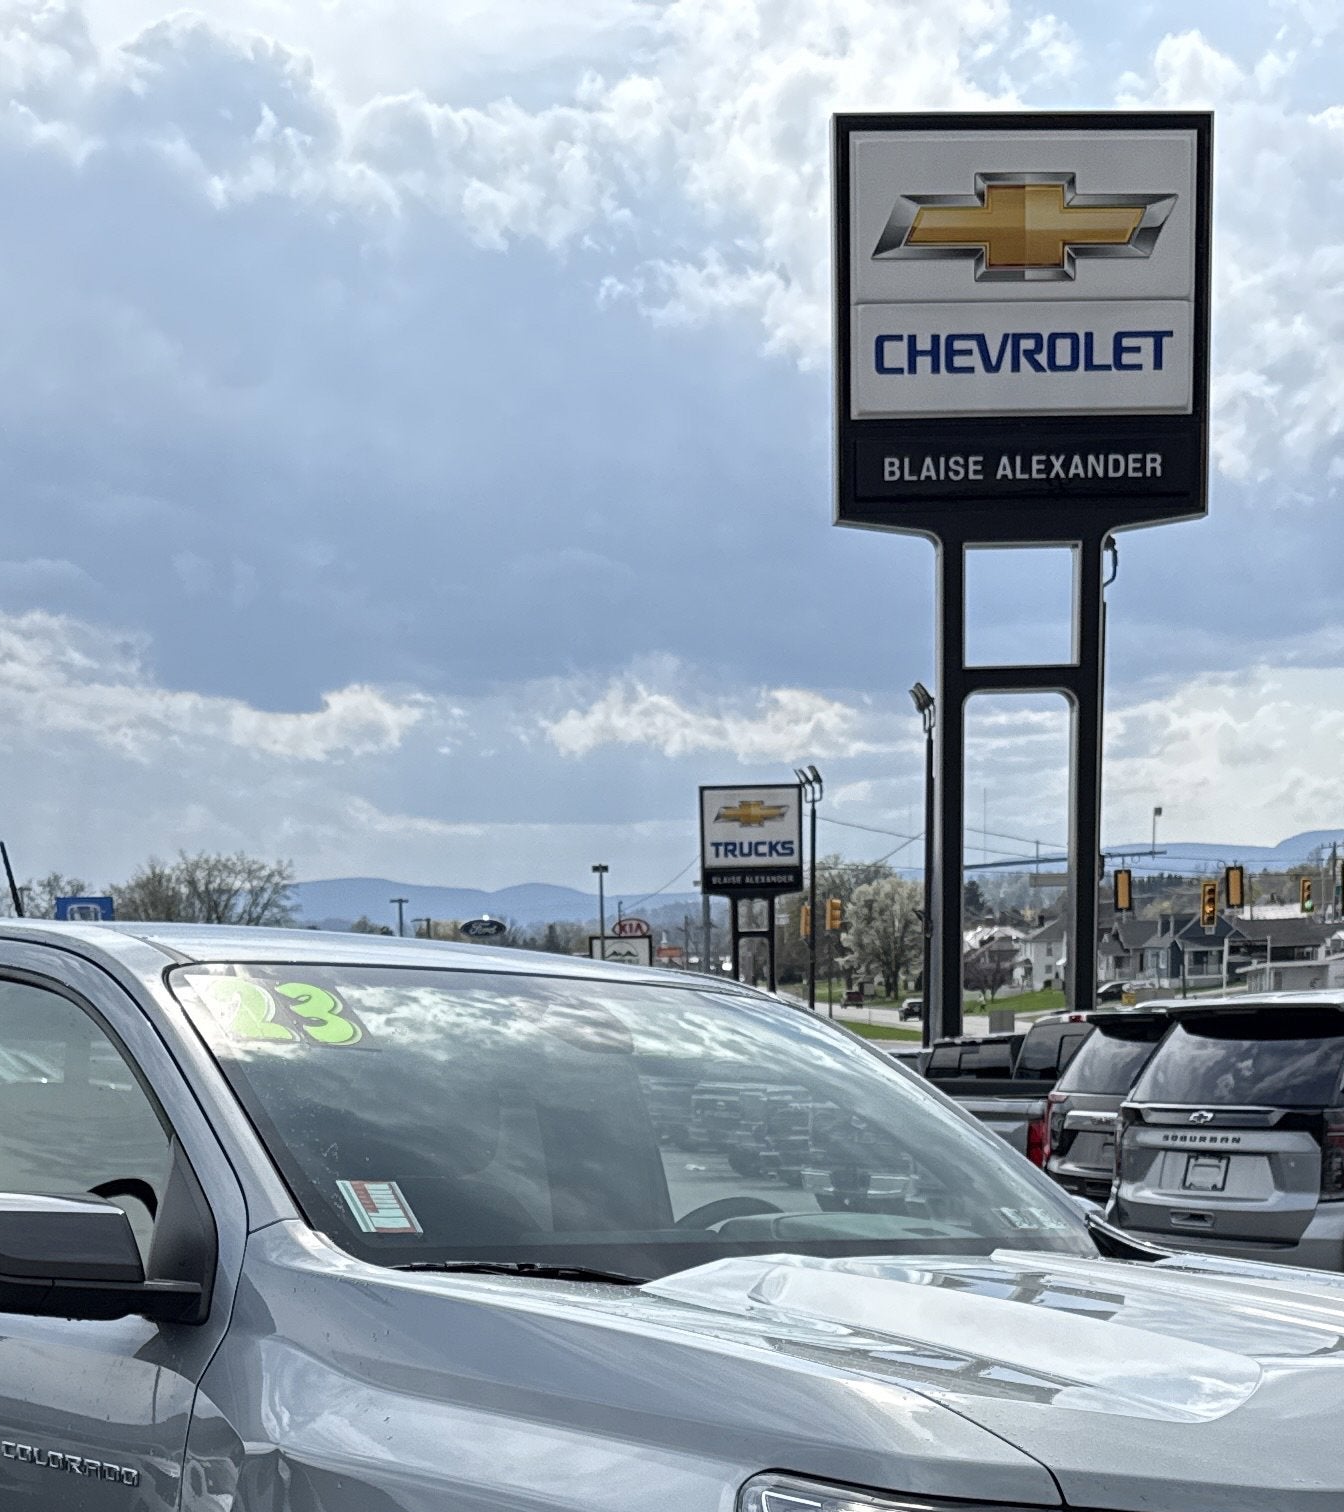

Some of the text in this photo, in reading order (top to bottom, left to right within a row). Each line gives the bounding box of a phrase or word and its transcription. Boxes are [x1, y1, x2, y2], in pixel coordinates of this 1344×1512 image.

[874, 330, 1174, 375] CHEVROLET
[883, 453, 1163, 482] BLAISE ALEXANDER
[711, 840, 795, 858] TRUCKS
[618, 922, 644, 935] KIA
[206, 979, 363, 1046] 23
[1162, 1134, 1241, 1144] SUBURBAN
[1, 1440, 140, 1487] COLORADO
